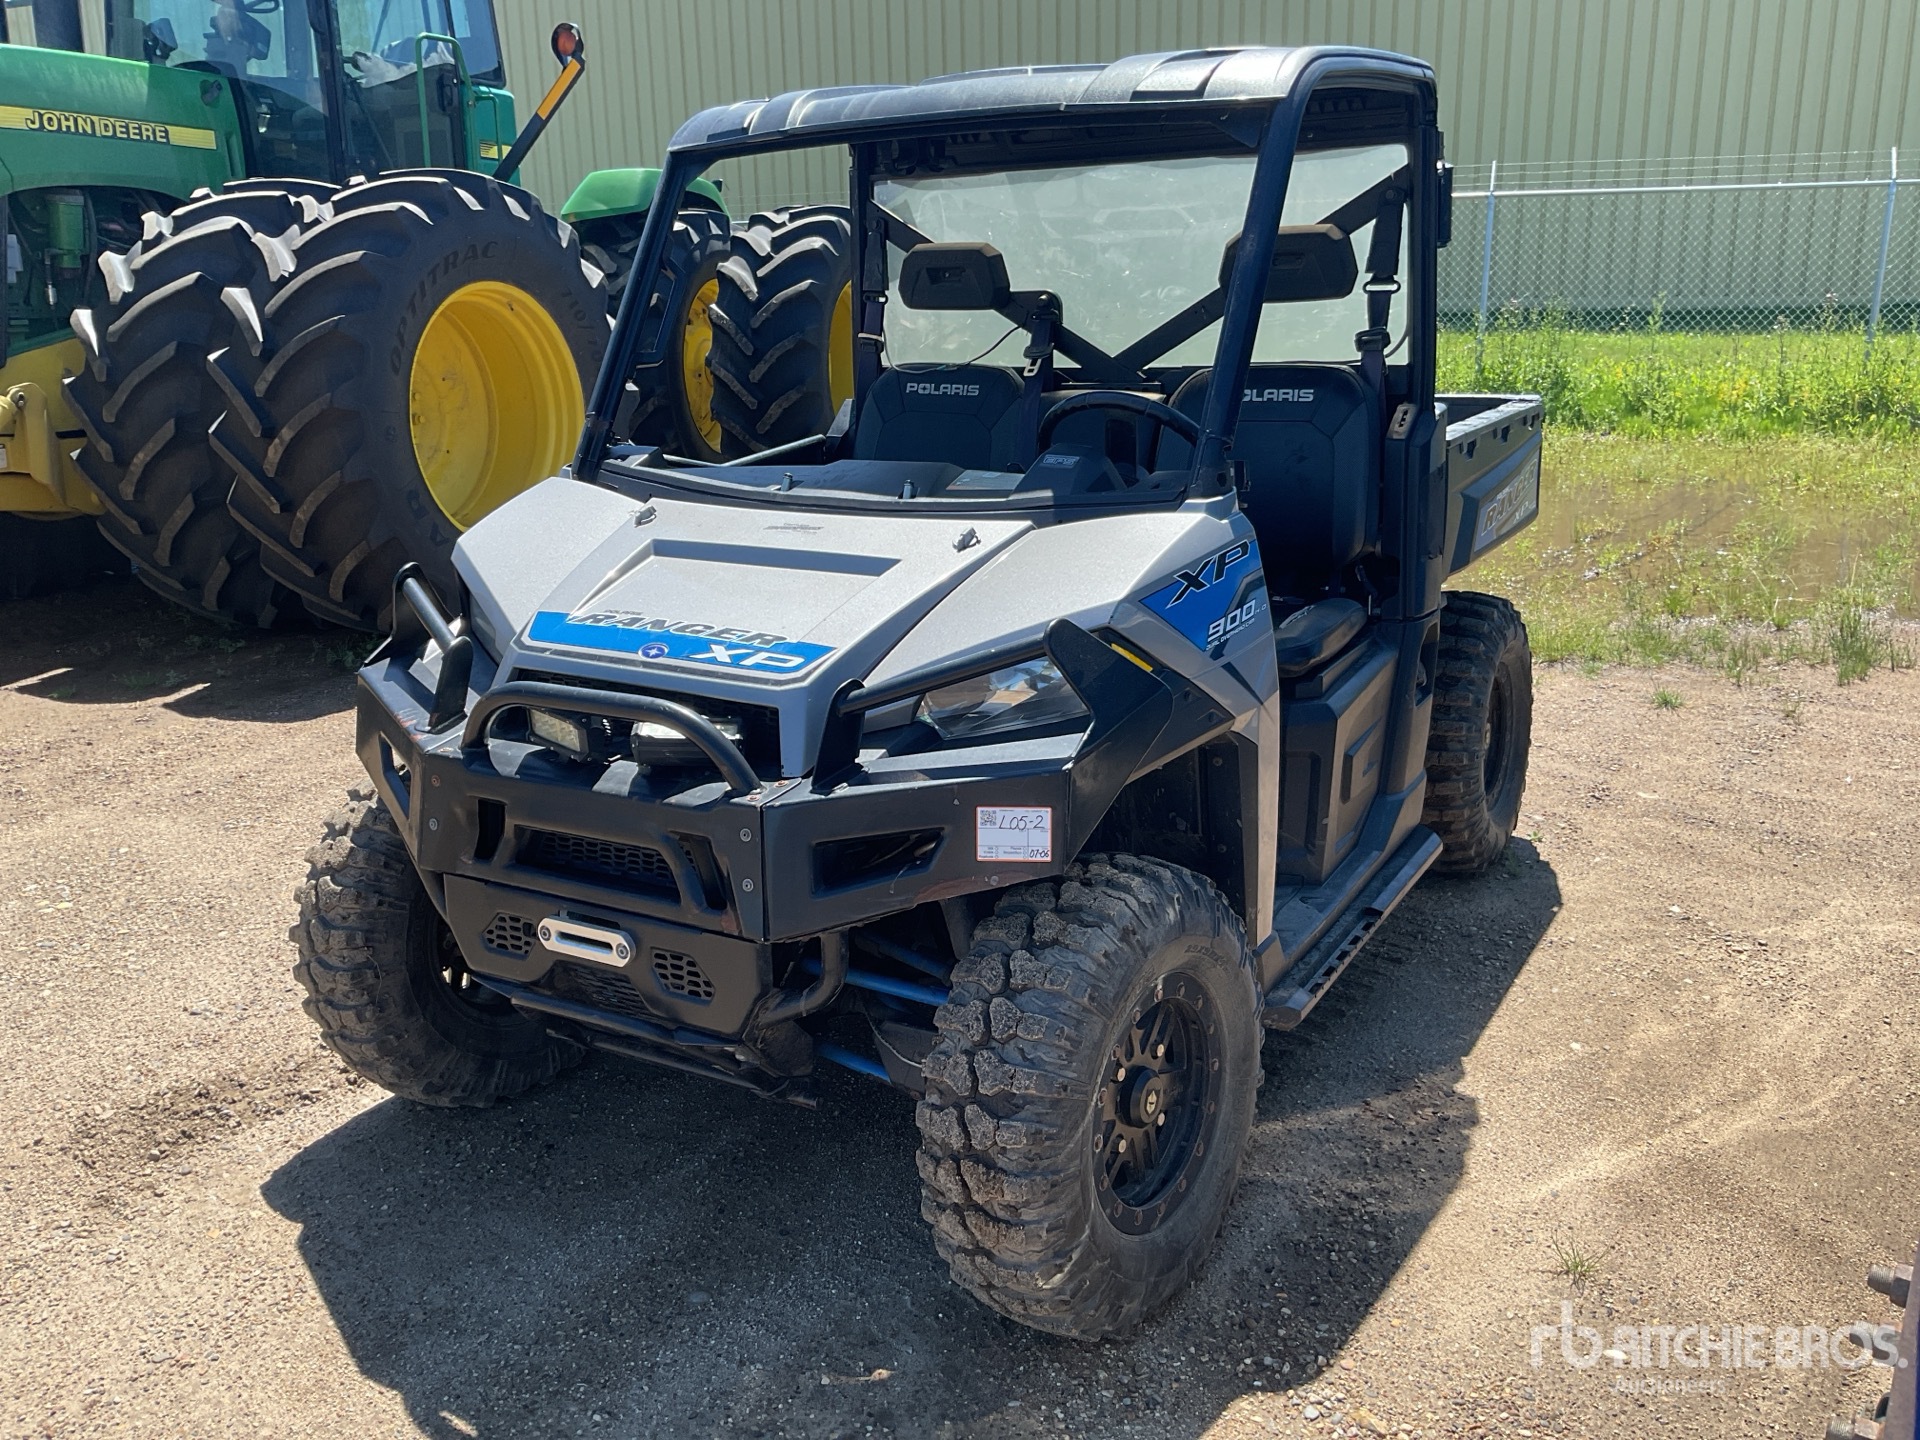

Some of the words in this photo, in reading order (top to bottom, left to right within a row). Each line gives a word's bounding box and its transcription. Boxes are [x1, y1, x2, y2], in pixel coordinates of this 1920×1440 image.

[25, 110, 97, 135] JOHN
[98, 116, 170, 144] DEERE
[391, 241, 499, 376] OPTITRAC
[906, 382, 980, 396] POLARIS
[1242, 388, 1314, 402] OLARIS
[1165, 539, 1251, 610] XP
[567, 611, 790, 648] RANGER
[1207, 599, 1256, 642] 900
[690, 643, 806, 669] XP
[999, 814, 1045, 830] L05-2
